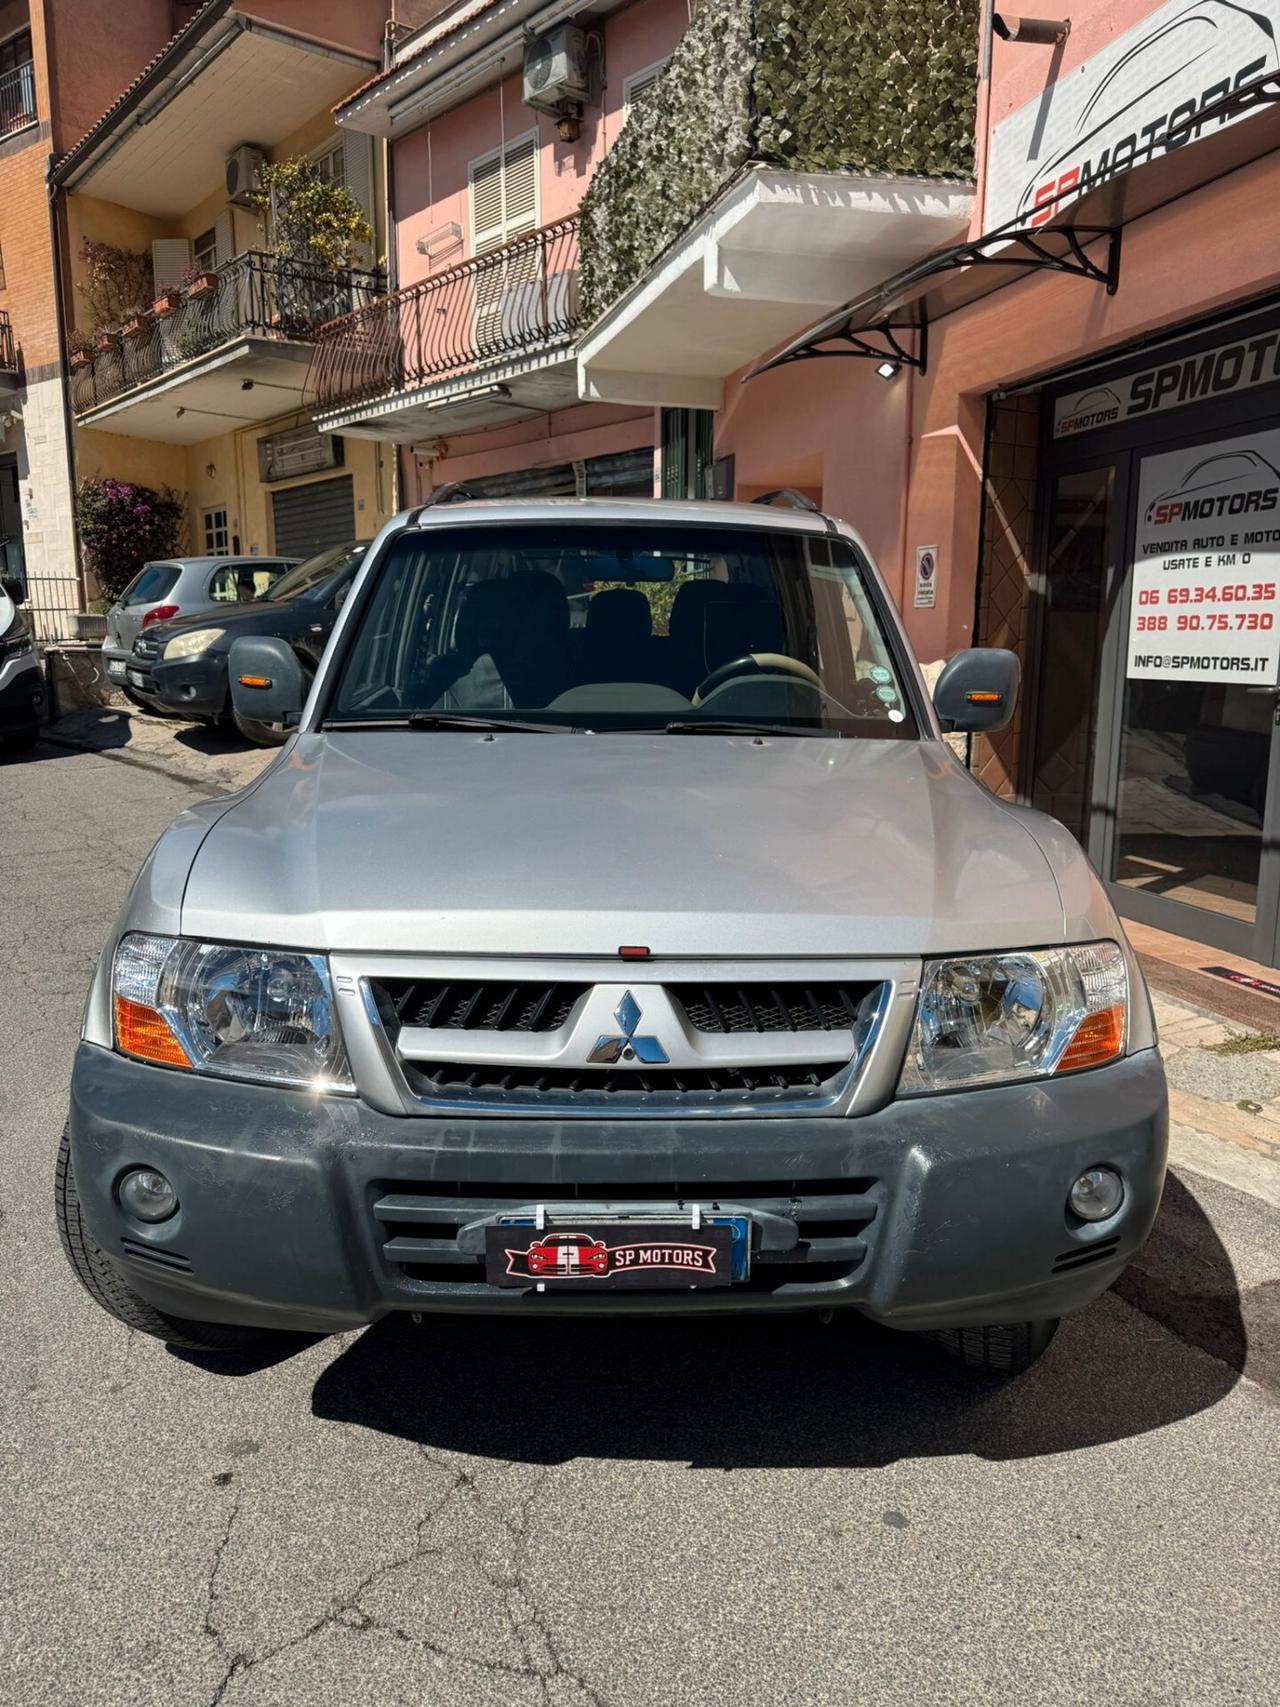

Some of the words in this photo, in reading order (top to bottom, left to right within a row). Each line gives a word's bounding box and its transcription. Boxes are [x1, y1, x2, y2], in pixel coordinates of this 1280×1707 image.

[1060, 407, 1119, 433] SPMOTORS
[1154, 487, 1279, 525] SPMOTORS
[1142, 539, 1187, 554] VENDITA
[1192, 535, 1225, 549] AUTO
[1230, 534, 1239, 546] E
[1243, 529, 1280, 544] MOTO
[1163, 557, 1200, 571] USATE
[1204, 556, 1212, 567] E
[1217, 554, 1236, 567] KM
[1138, 590, 1160, 605] 06
[1167, 583, 1276, 605] 69.34.60.35
[1136, 616, 1168, 632] 388
[1176, 613, 1274, 631] 90.75.730
[1134, 655, 1269, 672] INFO@SPMOTORS.IT
[615, 1252, 635, 1266] SP
[638, 1249, 703, 1267] MOTORS
